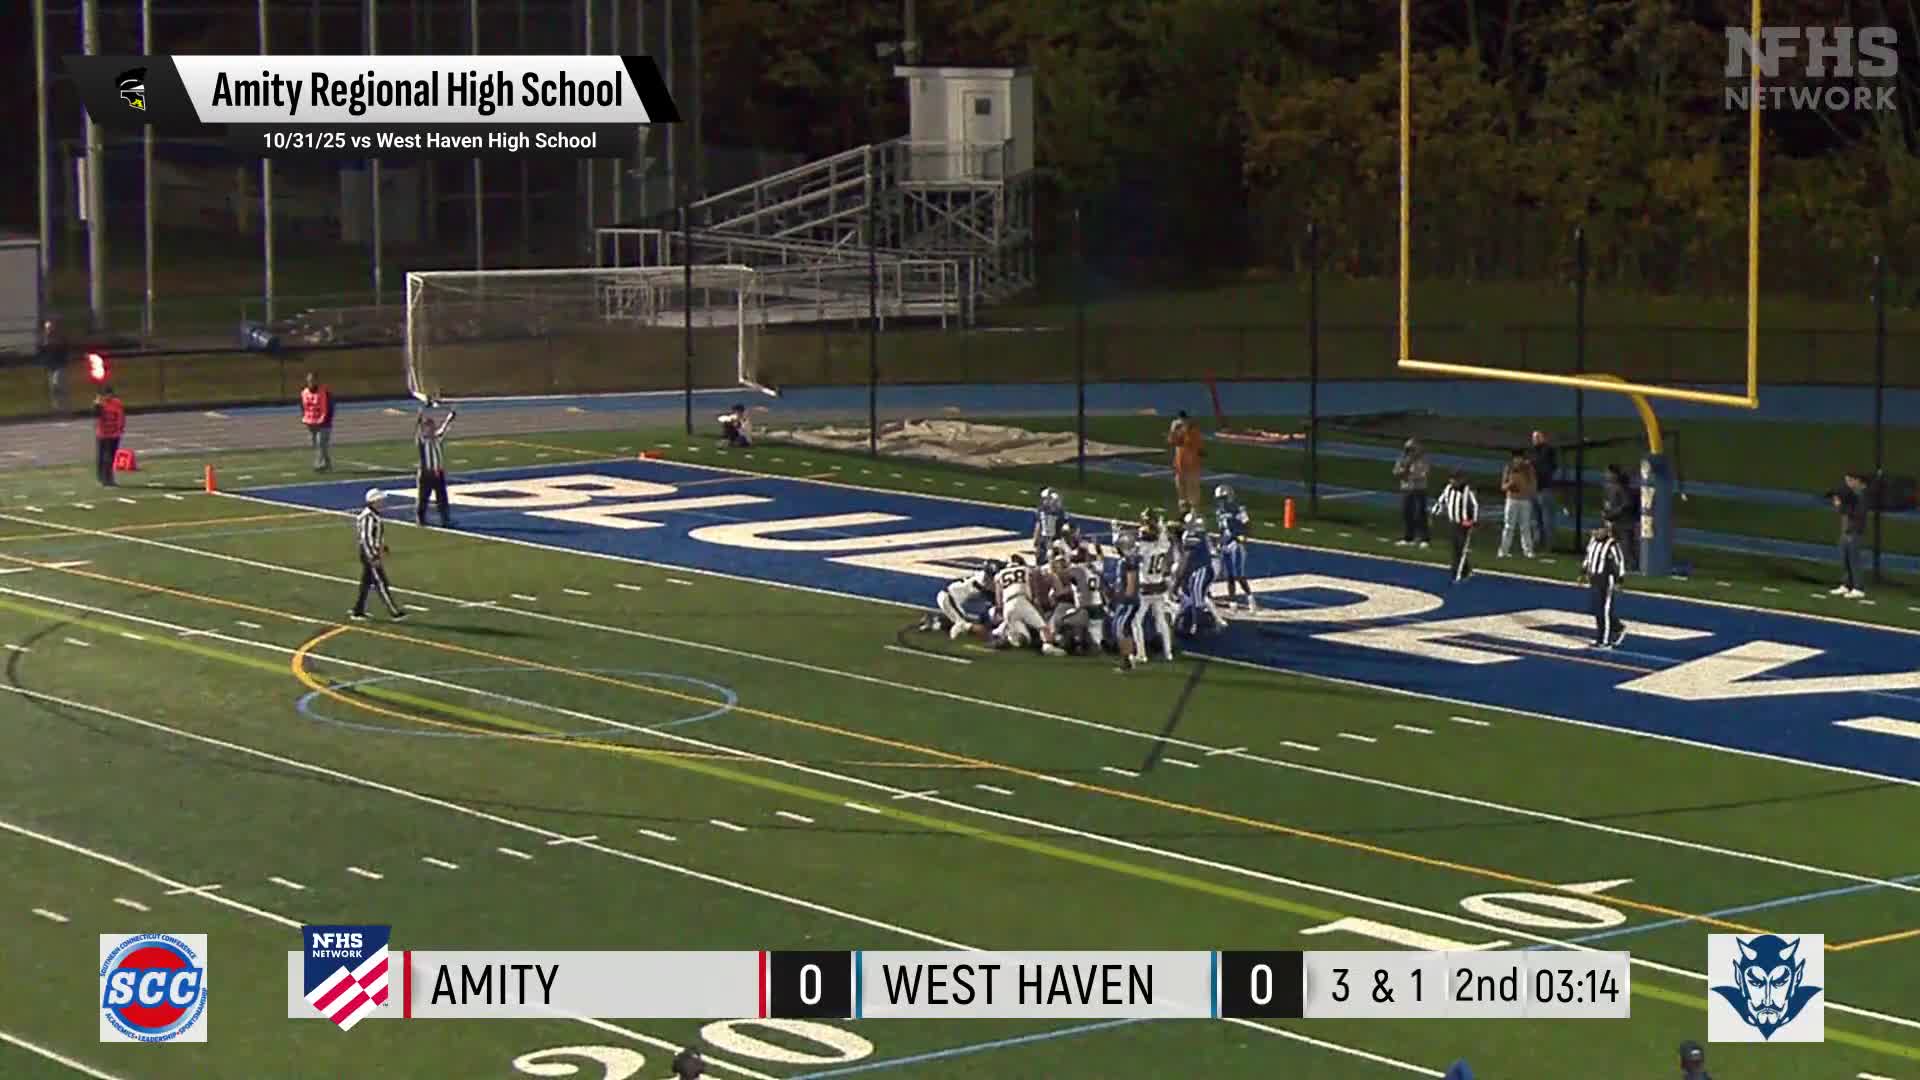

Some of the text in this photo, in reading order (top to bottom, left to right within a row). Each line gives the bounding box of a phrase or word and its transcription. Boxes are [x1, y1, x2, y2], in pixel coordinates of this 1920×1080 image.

[384, 474, 1920, 739] BLUE DEV
[1002, 569, 1025, 589] 58
